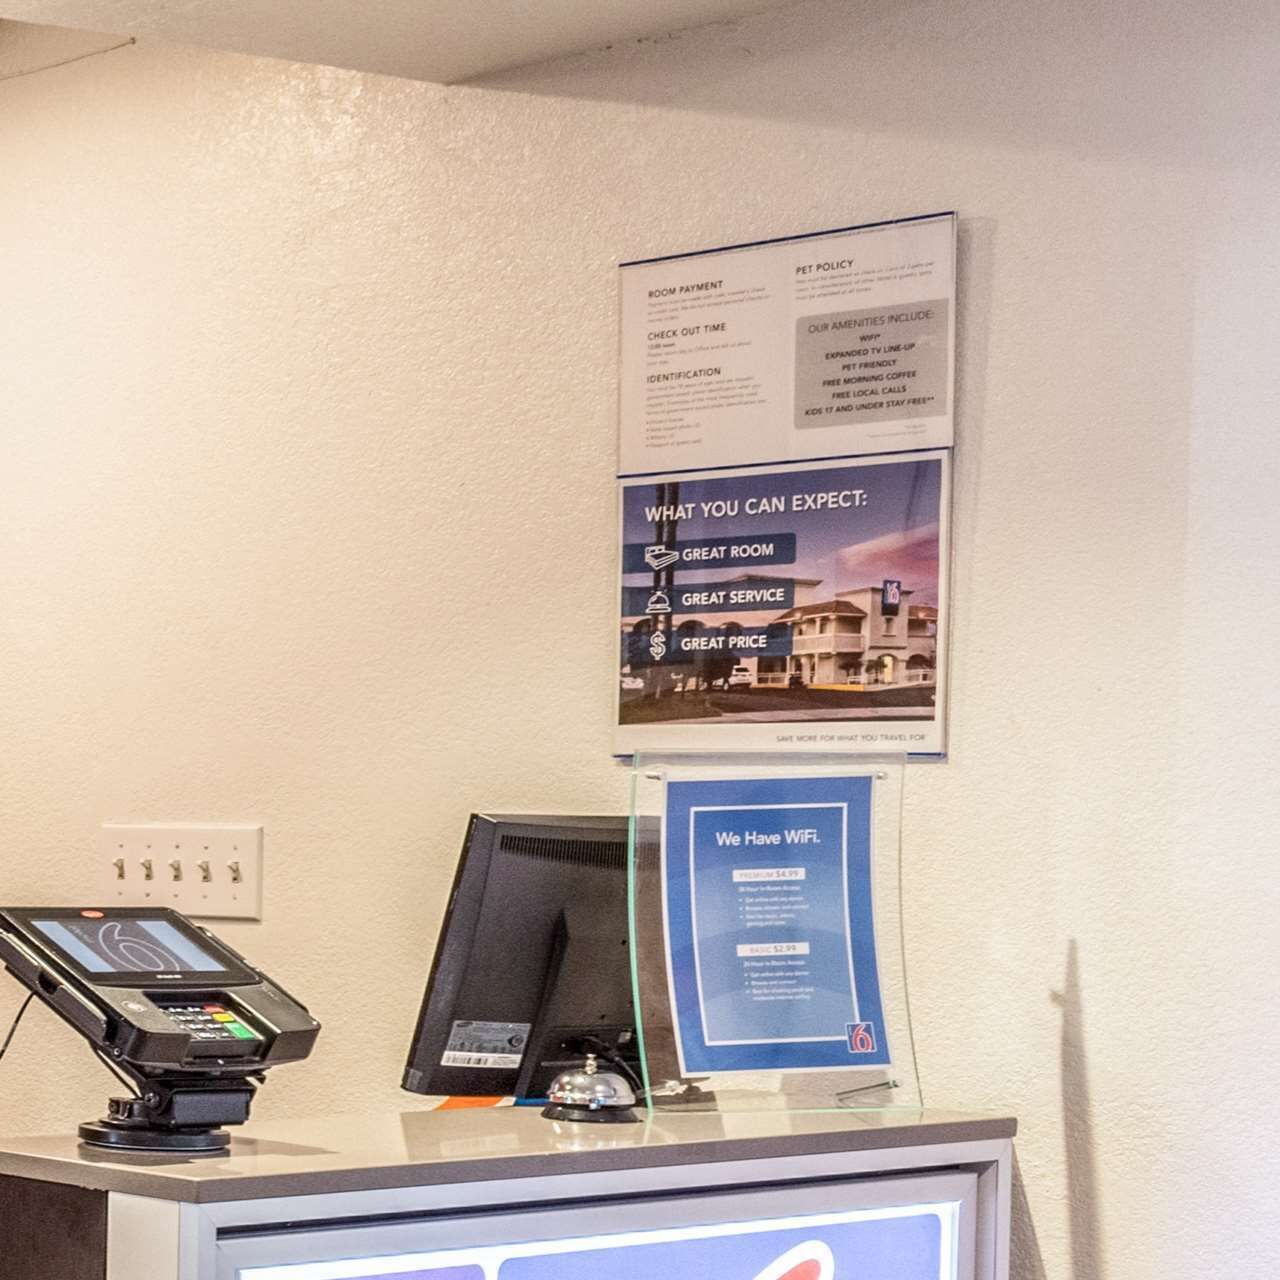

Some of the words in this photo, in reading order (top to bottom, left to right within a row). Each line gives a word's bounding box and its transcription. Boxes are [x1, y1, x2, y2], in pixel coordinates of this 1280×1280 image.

[796, 265, 812, 275] PET
[816, 259, 854, 272] POLICY
[648, 287, 676, 298] ROOM
[680, 280, 723, 293] PAYMENT
[808, 323, 828, 334] OUR
[831, 315, 885, 330] AMENITIES
[887, 310, 934, 324] INCLUDE:
[648, 330, 678, 341] CHECK
[681, 326, 700, 337] OUT
[704, 322, 726, 333] TIME
[825, 348, 869, 360] EXPANDED
[871, 347, 882, 355] TV
[883, 342, 916, 353] LINE-UP
[842, 363, 857, 371] PET
[859, 359, 897, 369] FRIENDLY
[646, 367, 721, 384] IDENTIFICATION
[822, 378, 841, 387] FREE
[843, 373, 884, 384] MORNING
[886, 370, 917, 380] COFFEE
[832, 391, 851, 399] FREE
[853, 388, 880, 398] LOCAL
[882, 385, 907, 394] CALLS
[805, 406, 822, 416] KIDS
[835, 404, 853, 412] AND
[855, 401, 884, 411] UNDER
[886, 398, 905, 408] STAY
[644, 503, 696, 523] WHAT
[700, 499, 739, 518] YOU
[745, 496, 786, 514] CAN
[792, 490, 868, 511] EXPECT:
[682, 546, 726, 562] GREAT
[730, 543, 774, 558] ROOM
[681, 591, 726, 606] GREAT
[729, 588, 785, 604] SERVICE
[680, 636, 725, 651] GREAT
[729, 634, 768, 649] PRICE
[776, 735, 793, 743] SAVE
[796, 734, 817, 742] MORE
[820, 734, 835, 742] FOR
[837, 734, 858, 742] WHAT
[861, 734, 878, 742] YOU
[880, 734, 908, 742] TRAVEL
[715, 831, 741, 846] We
[744, 830, 782, 846] Have
[783, 828, 821, 845] WiFi.
[851, 1023, 873, 1052] 6
